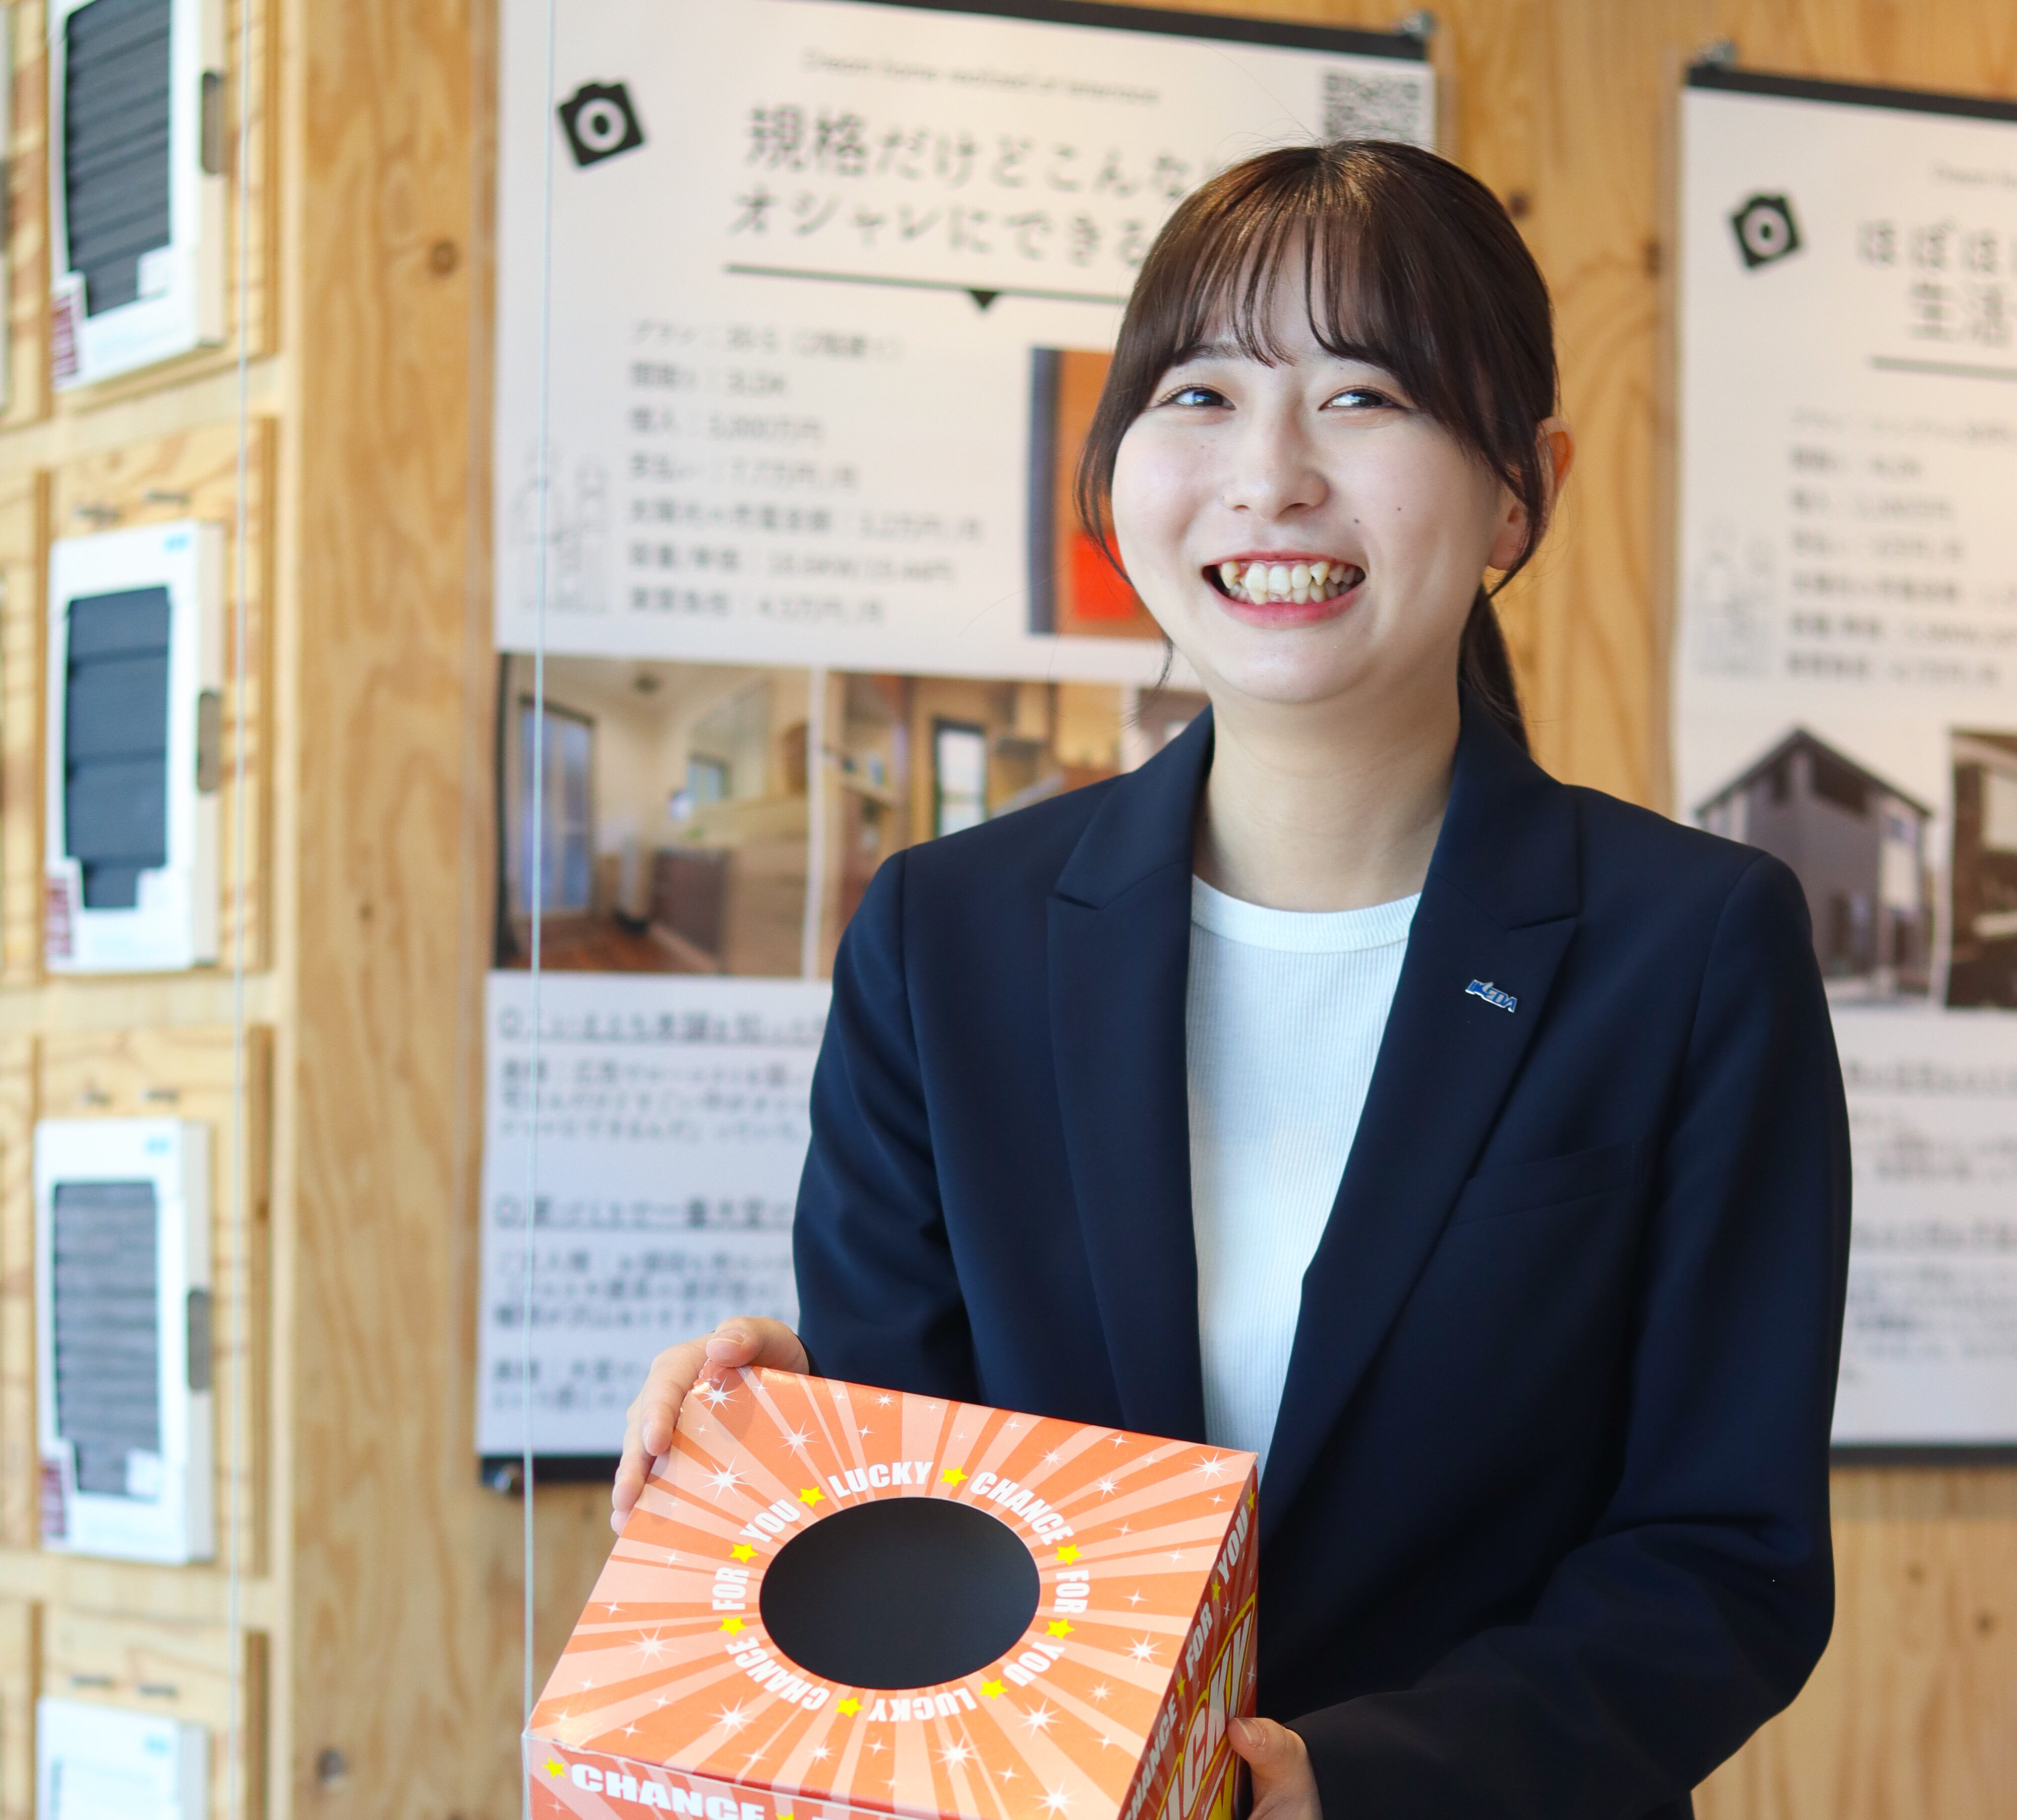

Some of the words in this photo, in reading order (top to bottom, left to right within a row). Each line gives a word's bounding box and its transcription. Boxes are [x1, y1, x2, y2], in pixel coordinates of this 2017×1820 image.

[744, 102, 1211, 202] 規格だけどこんな
[1859, 217, 2017, 275] ほぼほ
[827, 1461, 933, 1498] LUCKY
[739, 1499, 801, 1543] YOU
[970, 1472, 1075, 1545] CHANCE
[712, 1567, 750, 1611] FOR
[1053, 1570, 1090, 1613] FOR
[1185, 1601, 1213, 1681] FOR
[1217, 1504, 1249, 1585] YOU
[725, 1636, 830, 1711] CHANCE
[1003, 1642, 1065, 1686] YOU
[867, 1687, 978, 1722] LUCKY
[571, 1763, 765, 1820] CHANCE
